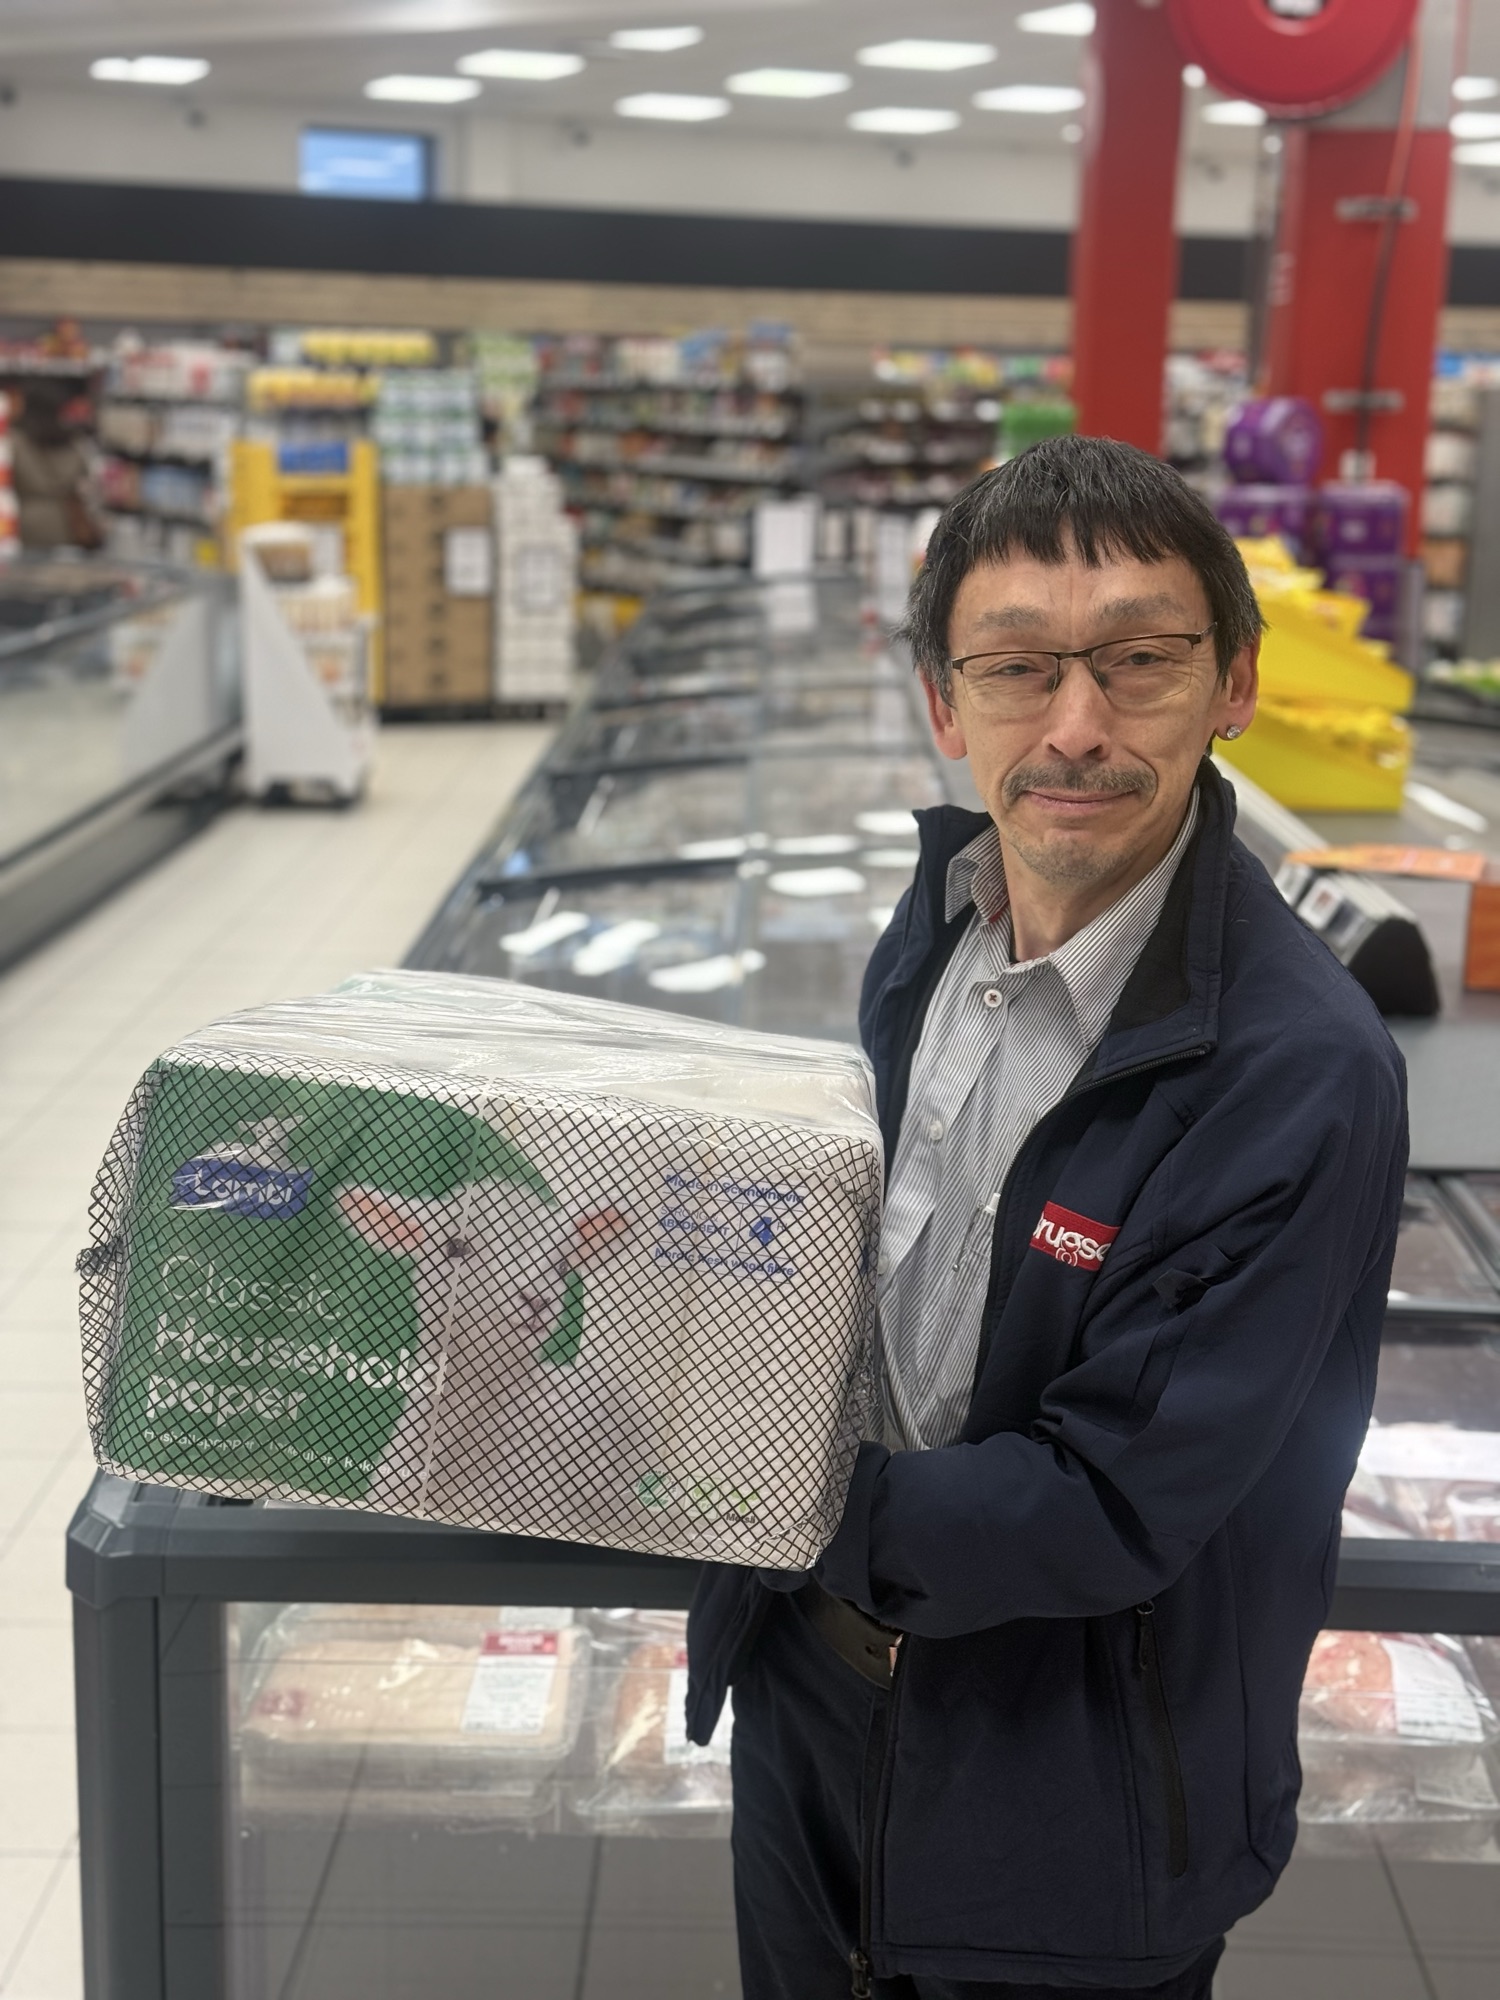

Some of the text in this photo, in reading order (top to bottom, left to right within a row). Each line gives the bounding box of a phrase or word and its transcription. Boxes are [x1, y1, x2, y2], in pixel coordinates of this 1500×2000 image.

[194, 1168, 293, 1206] Lambi
[666, 1174, 803, 1203] Made in Scandinavia
[658, 1218, 730, 1236] ABORBET
[749, 1216, 774, 1247] 4
[654, 1247, 694, 1263] Nordic
[767, 1262, 795, 1276] fibre
[162, 1255, 342, 1320] Classic
[154, 1311, 449, 1397] Household
[146, 1375, 308, 1428] paper
